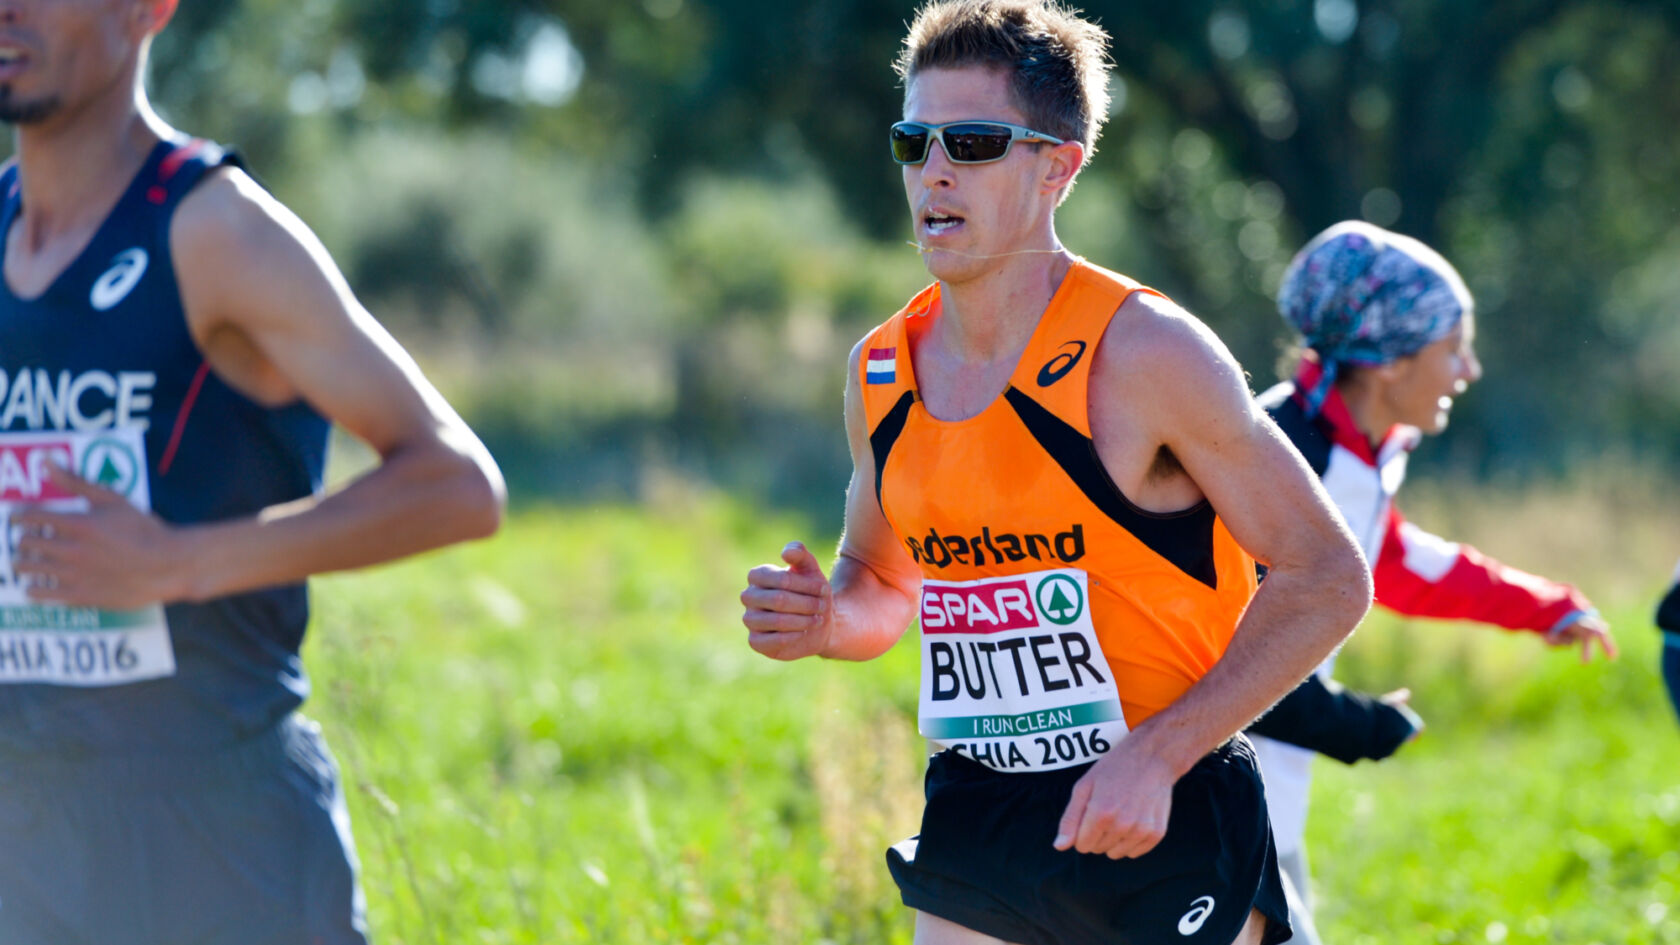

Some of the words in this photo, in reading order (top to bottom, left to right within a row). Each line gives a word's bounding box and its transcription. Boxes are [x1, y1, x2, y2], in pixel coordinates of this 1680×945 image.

[0, 367, 156, 431] ANCE
[923, 587, 1033, 628] SPAR
[57, 634, 139, 674] 2016
[930, 631, 1106, 702] BUTTER
[973, 719, 978, 735] I
[983, 717, 1013, 735] RUN
[1015, 708, 1073, 732] CLEAN
[1034, 728, 1111, 765] 2016
